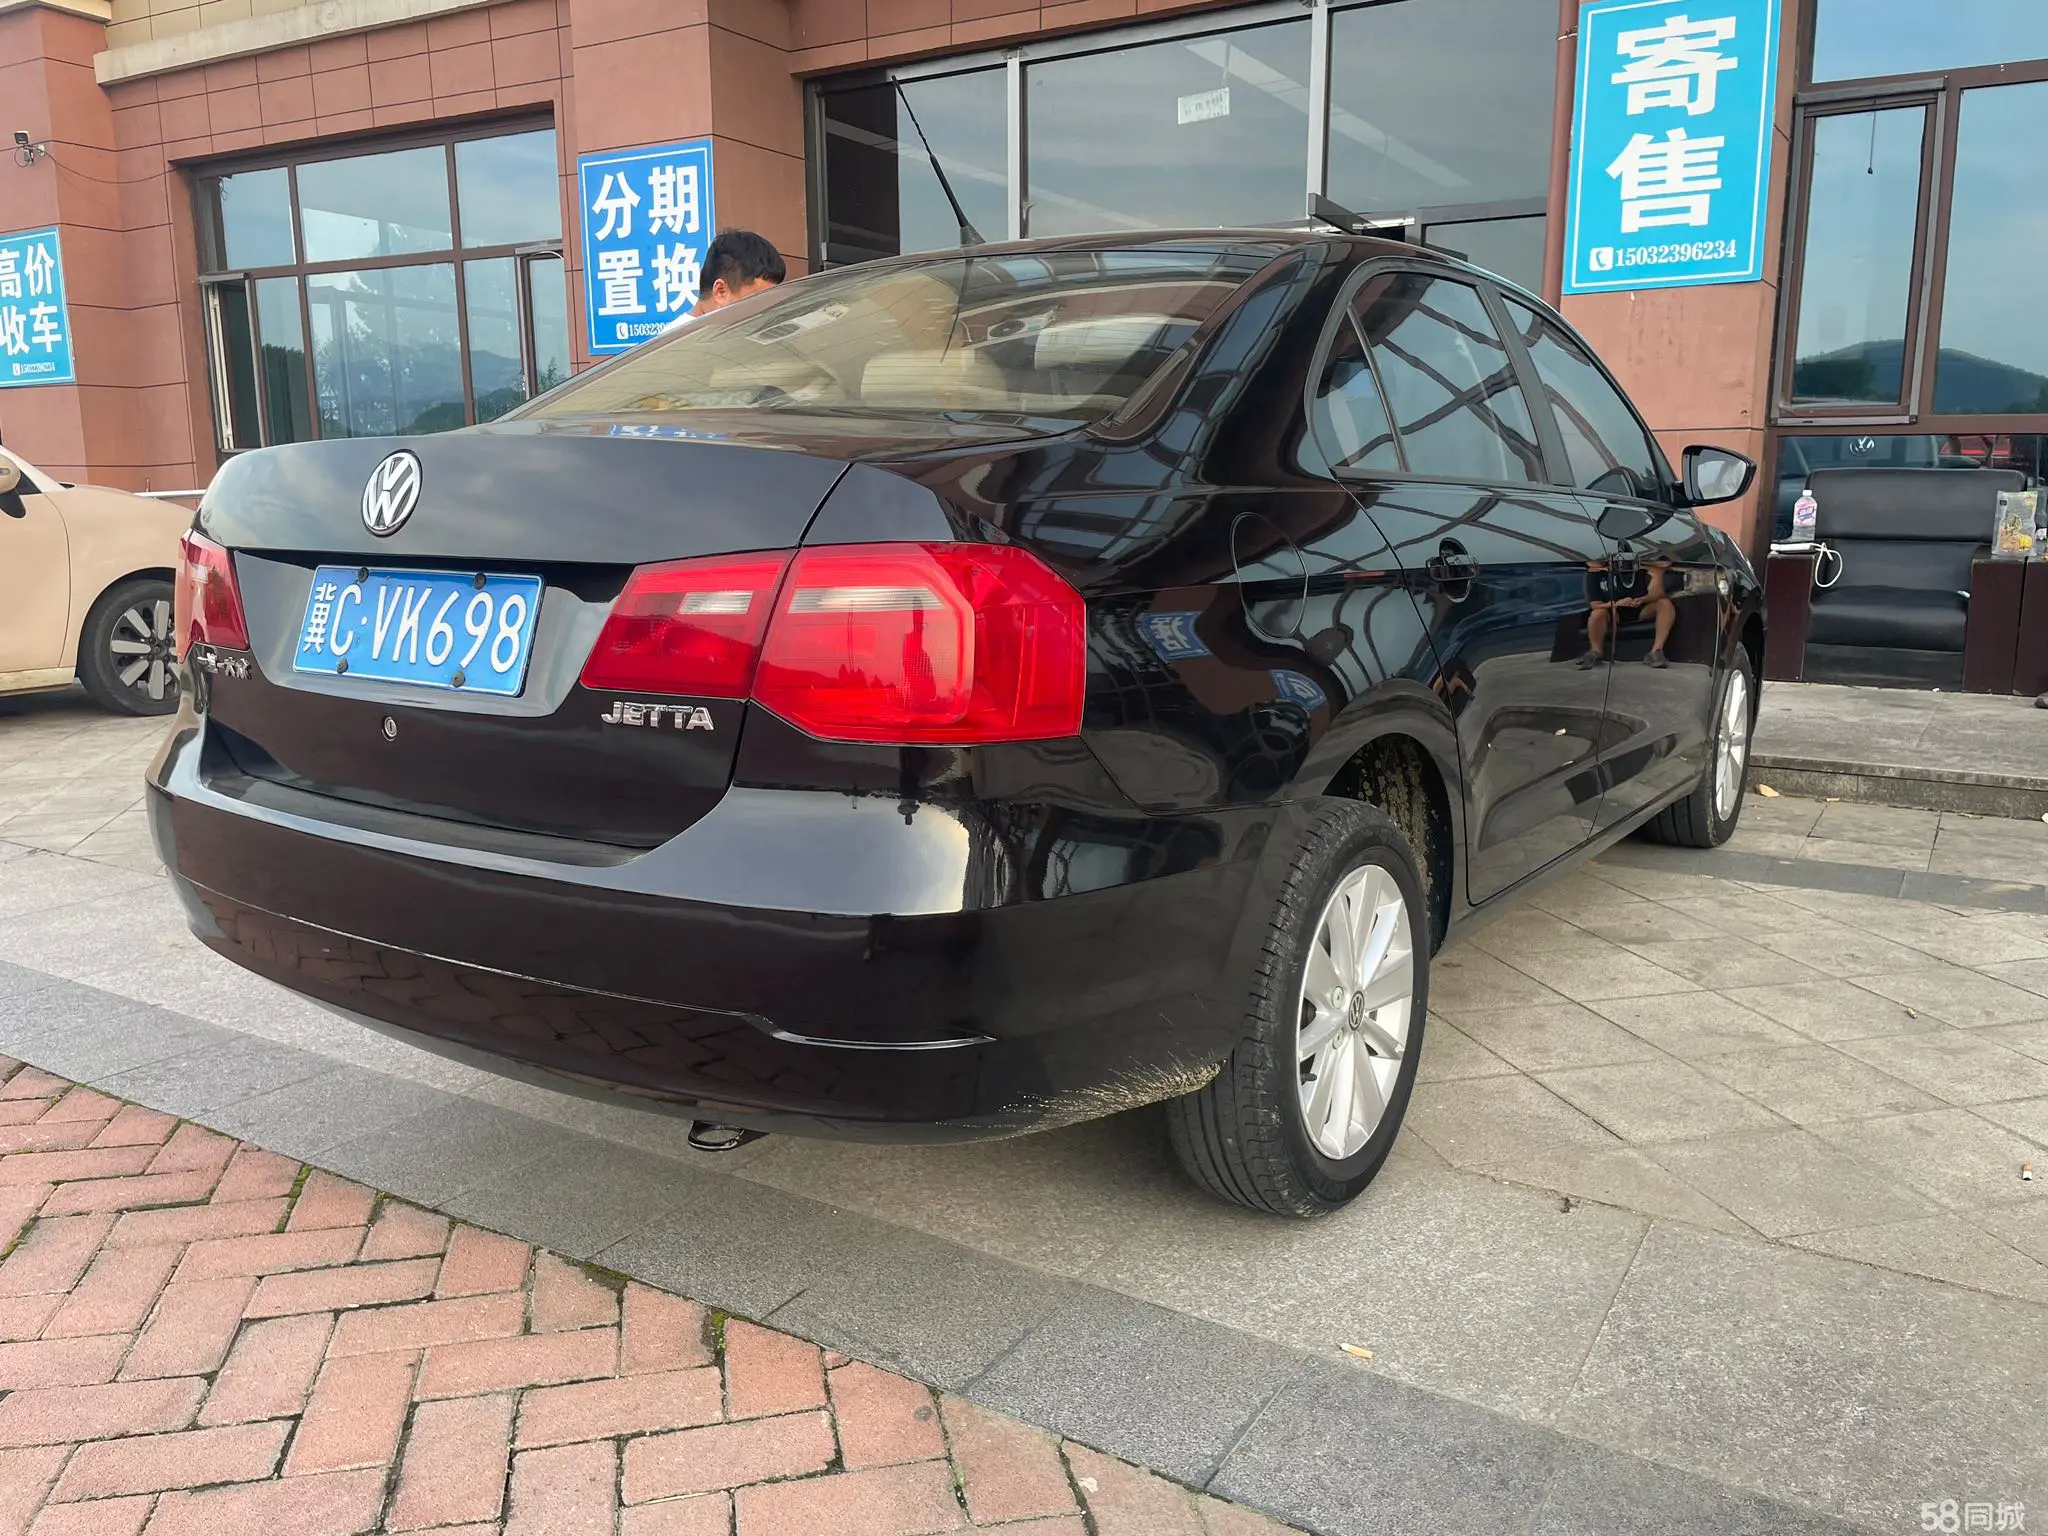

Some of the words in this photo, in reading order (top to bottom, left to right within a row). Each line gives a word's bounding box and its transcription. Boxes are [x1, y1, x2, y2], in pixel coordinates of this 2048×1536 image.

[1605, 14, 1739, 233] 寄售
[591, 165, 700, 241] 分期
[597, 242, 700, 316] 置换
[1615, 239, 1737, 267] 15032396234
[0, 301, 62, 356] 收车
[600, 701, 715, 731] JETTA
